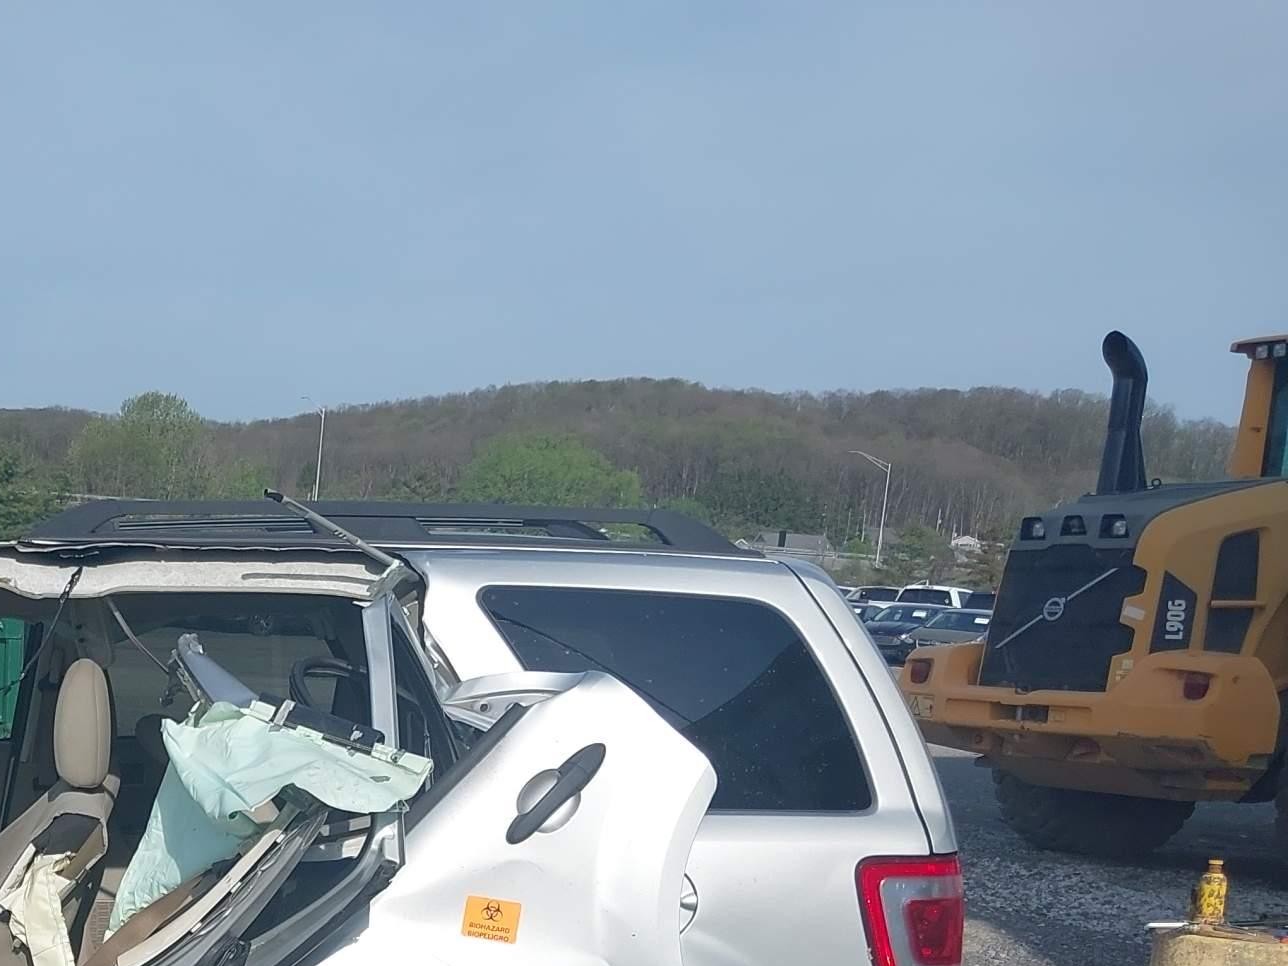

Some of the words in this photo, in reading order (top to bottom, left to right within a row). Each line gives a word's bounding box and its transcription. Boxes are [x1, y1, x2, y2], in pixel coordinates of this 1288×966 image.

[1165, 600, 1186, 640] L90G
[468, 921, 511, 935] BIOHAZARD
[467, 930, 510, 943] BIOPELIGRO
